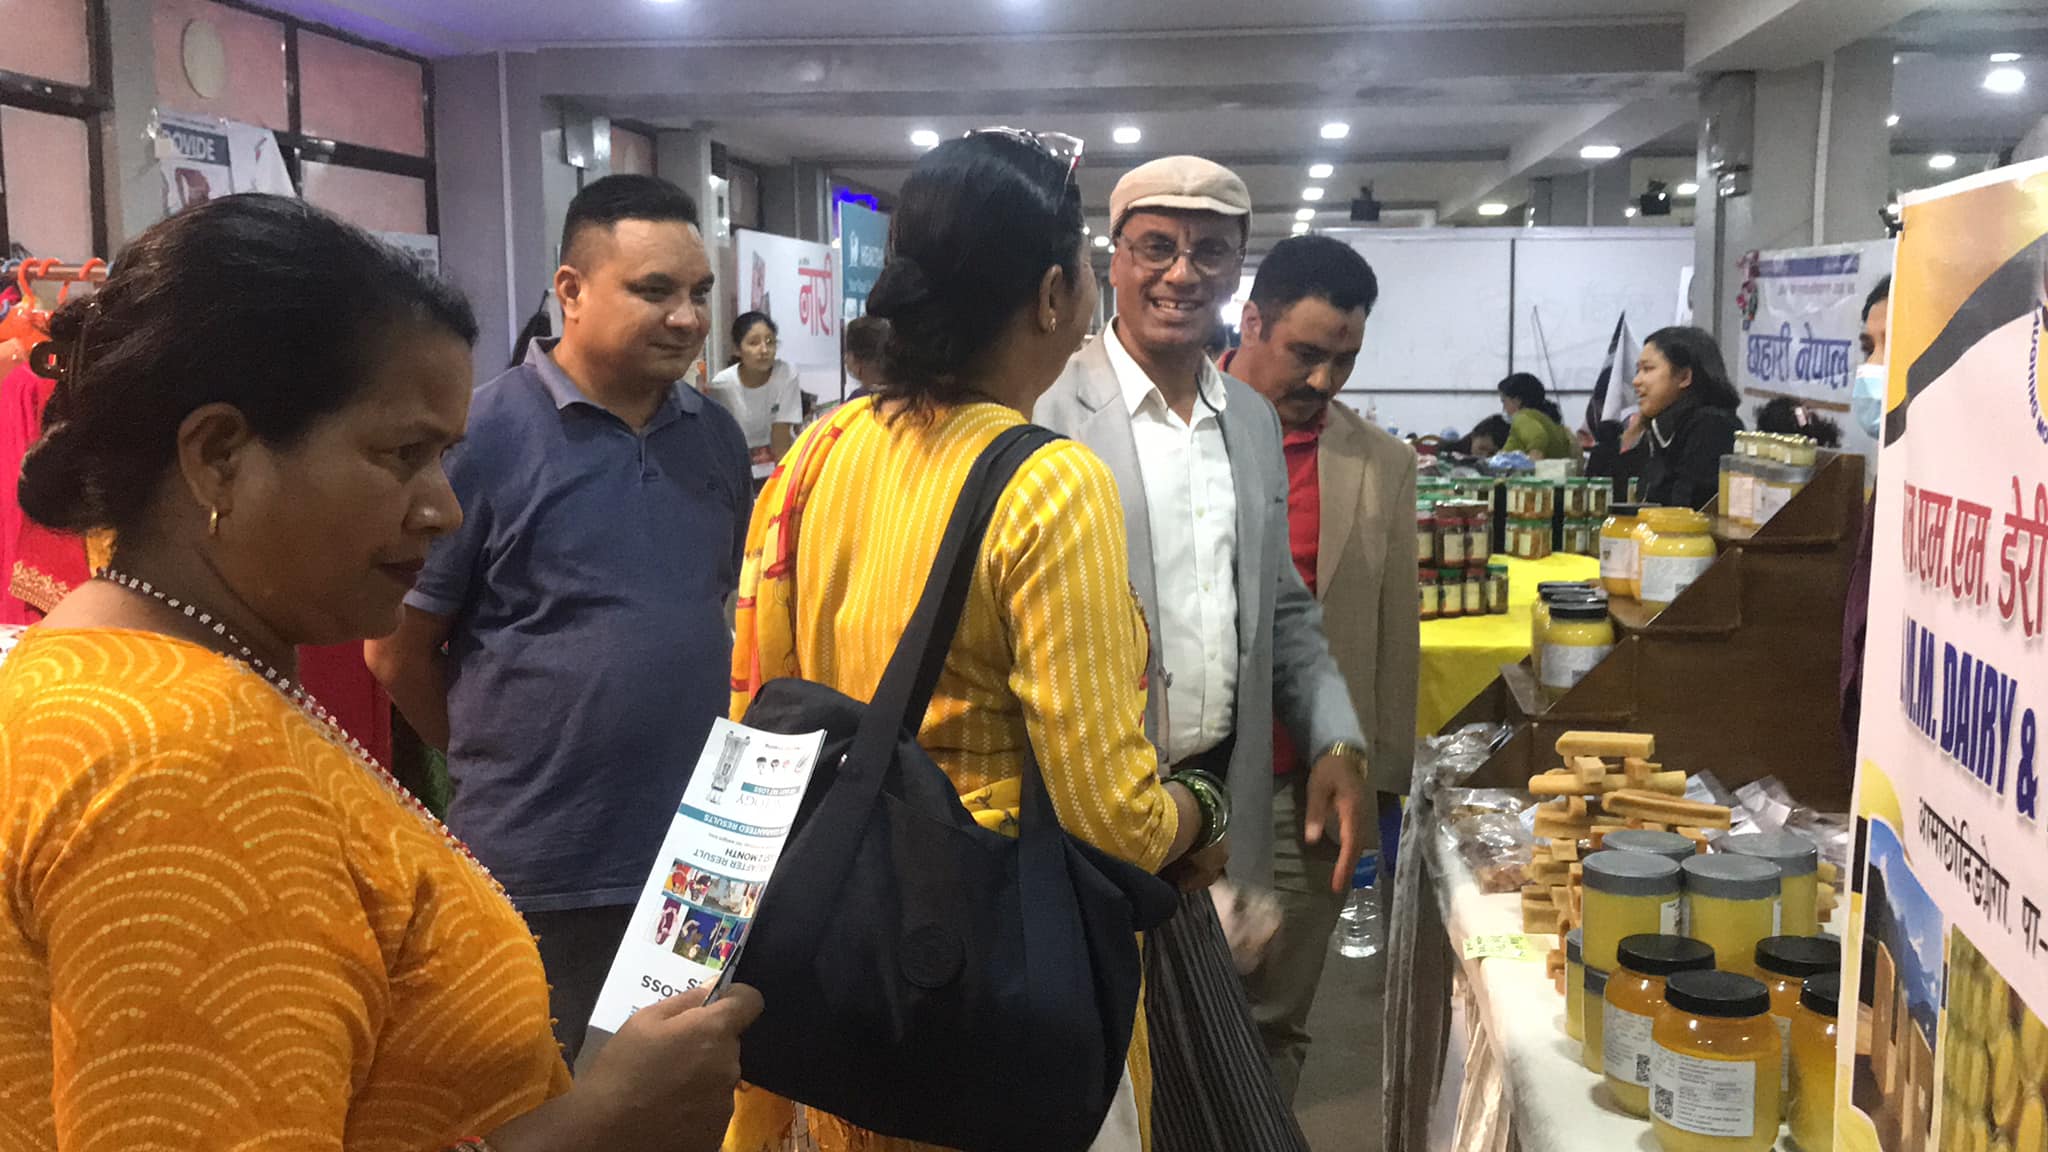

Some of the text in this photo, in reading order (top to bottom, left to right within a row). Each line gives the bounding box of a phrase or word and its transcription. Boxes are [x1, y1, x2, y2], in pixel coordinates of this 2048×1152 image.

[798, 252, 834, 336] नारी
[1747, 321, 1852, 390] छहारी नेपाल
[1940, 641, 2018, 795] DAIRY
[2016, 708, 2038, 820] &
[703, 813, 738, 830] RESULTS
[692, 848, 729, 867] RESULT
[724, 847, 757, 862] MONTH
